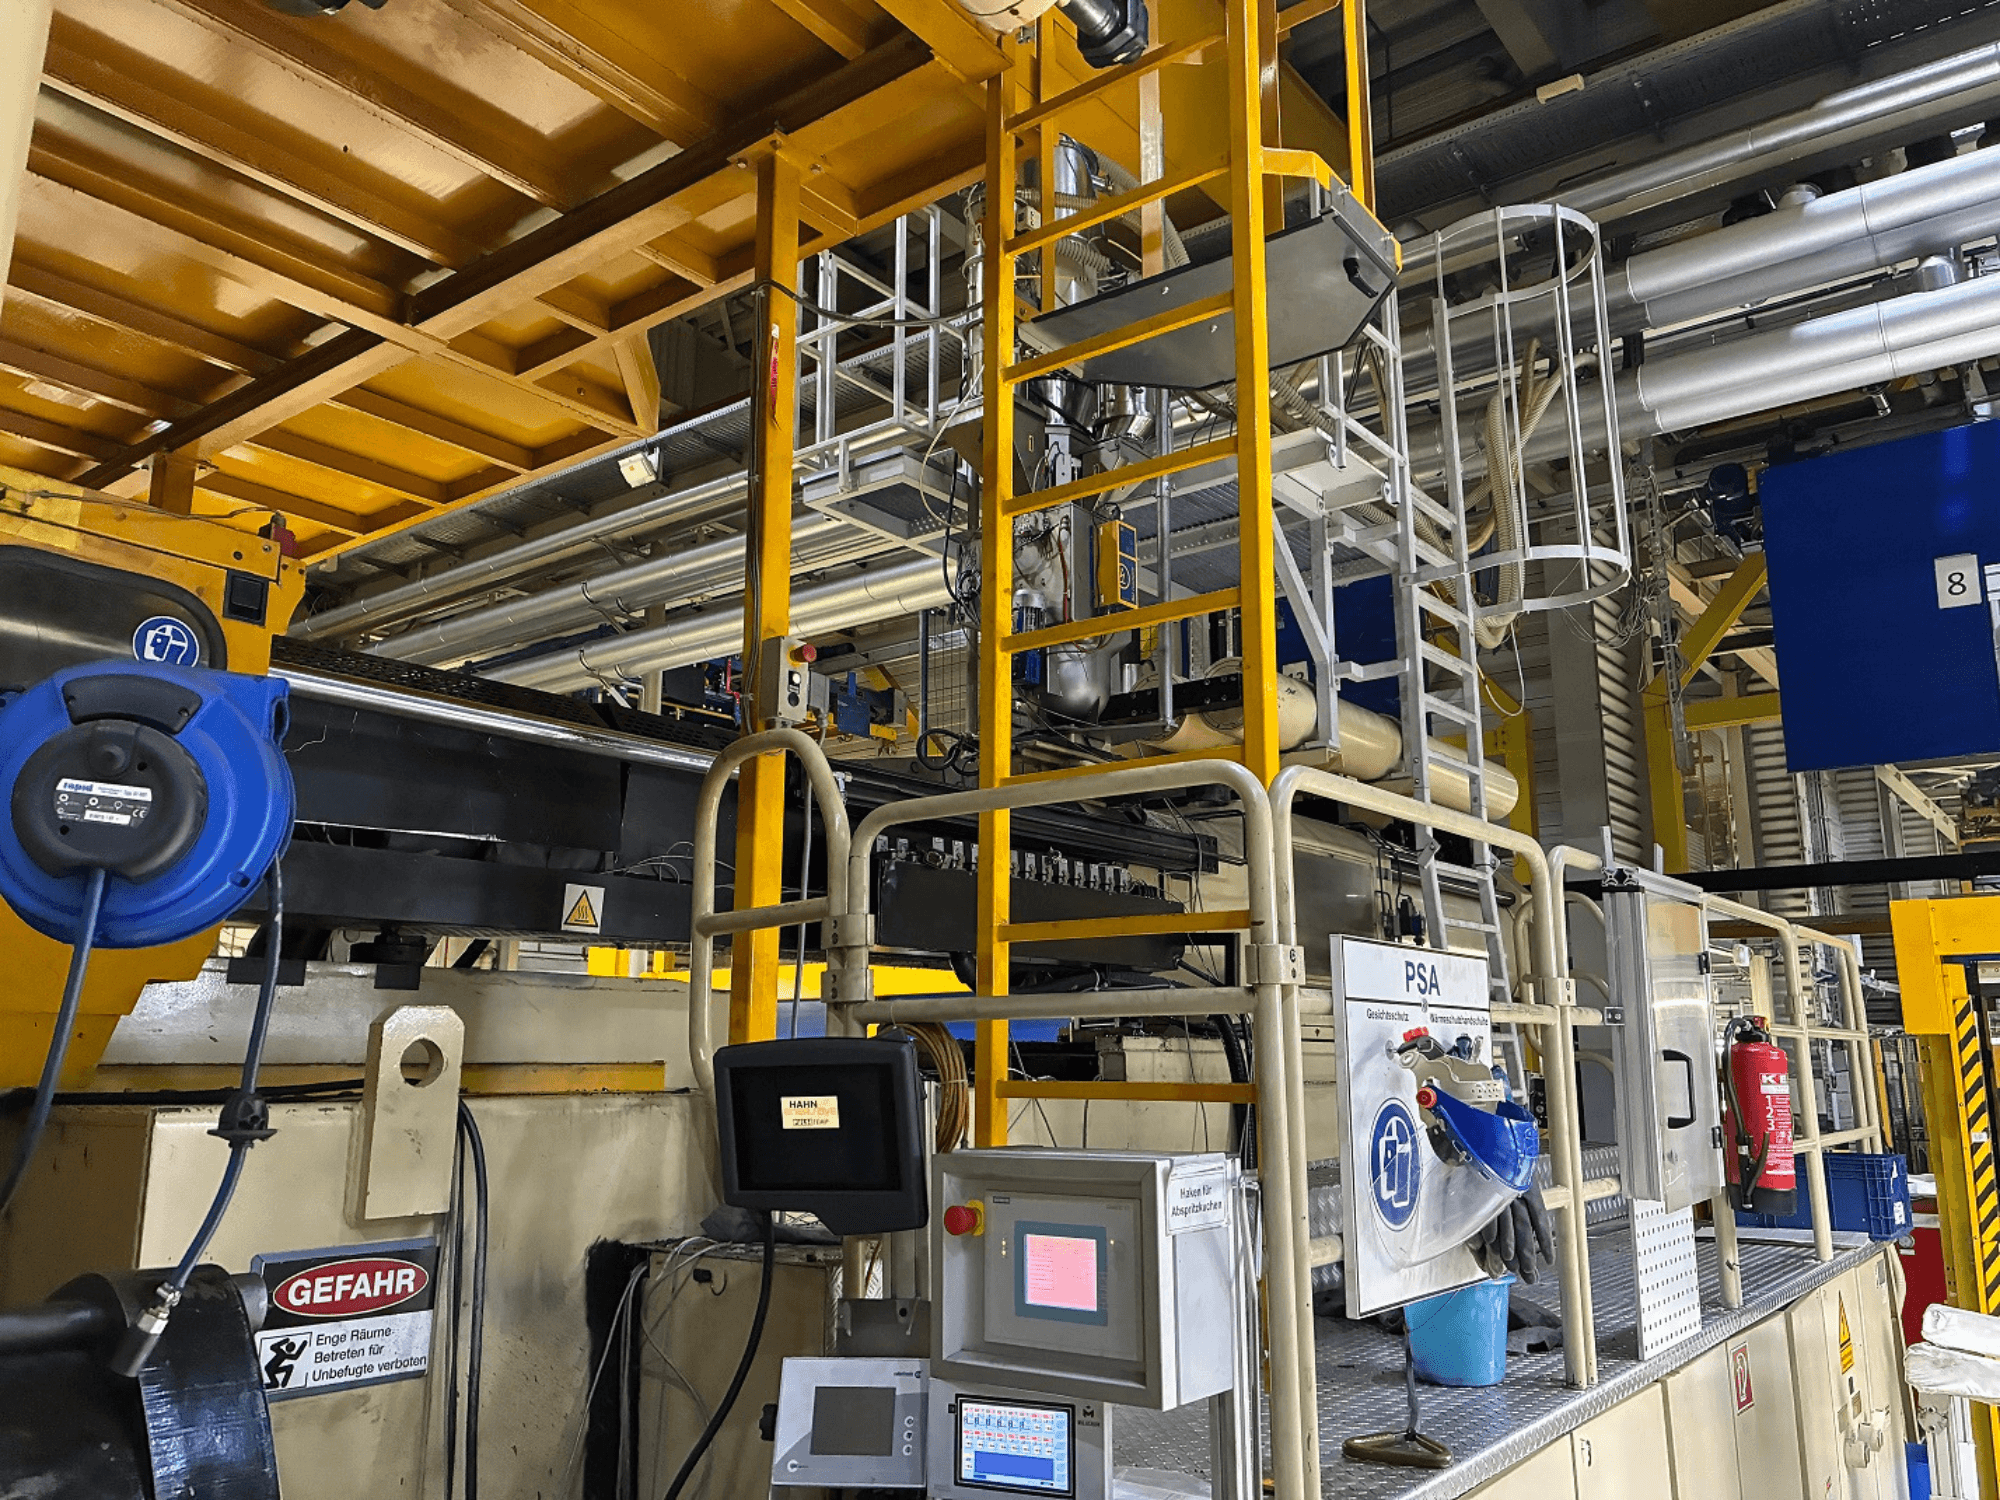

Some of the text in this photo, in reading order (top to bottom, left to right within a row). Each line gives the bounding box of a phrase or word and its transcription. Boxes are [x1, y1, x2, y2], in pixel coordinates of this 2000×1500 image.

[1947, 572, 1967, 596] 8
[1404, 960, 1441, 996] PSA
[1366, 1008, 1410, 1022] Gesichtsschutz
[789, 1100, 818, 1109] HAHN
[1180, 1184, 1212, 1199] Haken für
[1171, 1200, 1222, 1218] Abspritzkuchen
[287, 1268, 416, 1307] GEFAHR
[316, 1326, 392, 1347] Enge Räume
[314, 1344, 385, 1364] Betreten für
[312, 1356, 427, 1382] Unbefugte verboten
